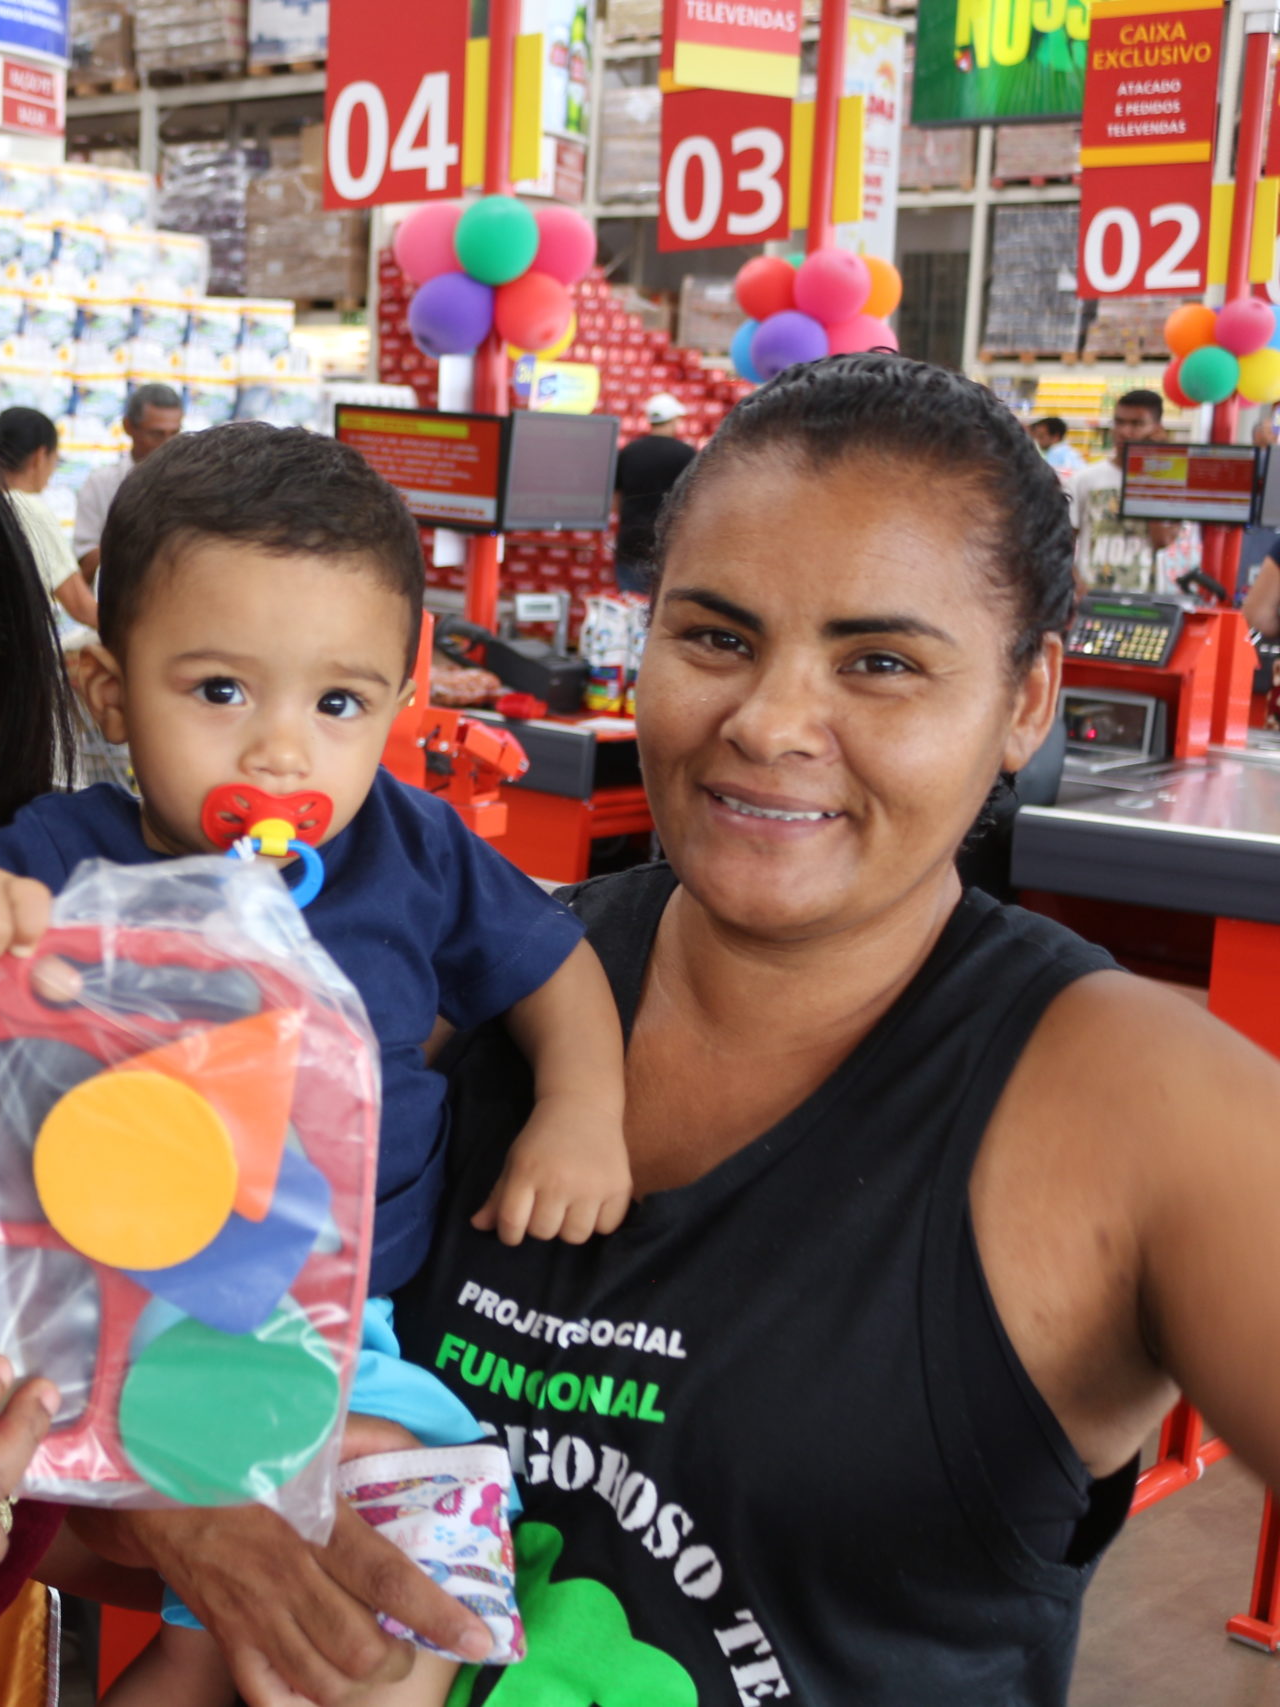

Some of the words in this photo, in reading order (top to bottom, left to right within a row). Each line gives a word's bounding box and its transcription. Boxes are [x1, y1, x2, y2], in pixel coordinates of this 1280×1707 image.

[684, 0, 797, 32] TELEVENDAS
[1119, 21, 1188, 45] CAIXA
[1092, 42, 1212, 71] EXCLUSIVO
[1116, 79, 1183, 96] ATACADO
[1114, 102, 1123, 117] E
[1125, 98, 1181, 116] PEDIDOS
[328, 71, 459, 201] 04
[1106, 119, 1187, 138] TELEVENDAS
[665, 126, 786, 241] 03
[1083, 202, 1201, 293] 02
[569, 1317, 687, 1360] SOCIAL
[477, 1420, 723, 1601] IGOROSO
